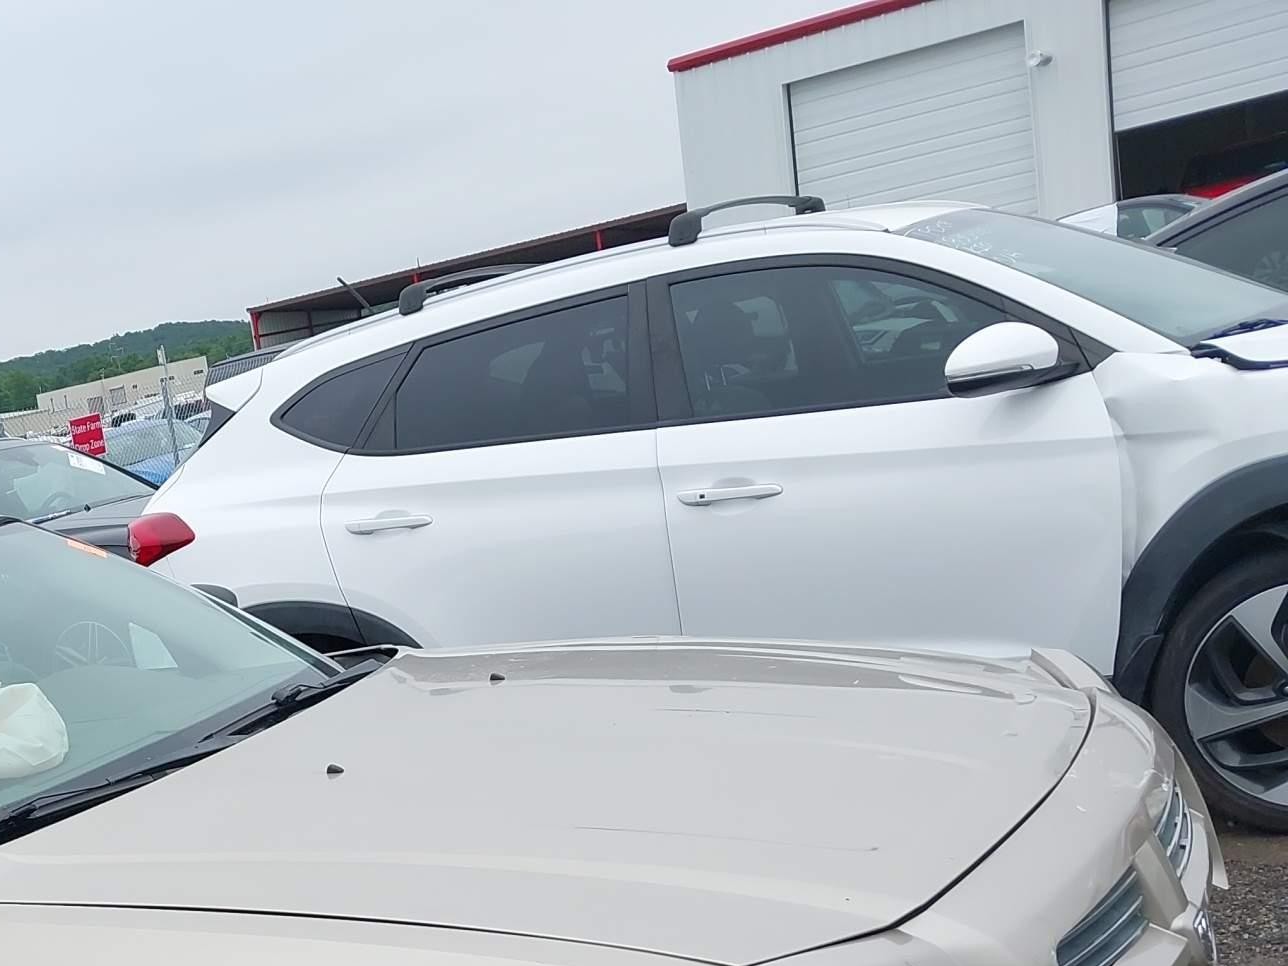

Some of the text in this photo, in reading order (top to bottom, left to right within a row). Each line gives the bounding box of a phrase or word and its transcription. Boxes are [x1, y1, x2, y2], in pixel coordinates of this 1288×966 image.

[72, 421, 101, 435] State Farm
[90, 440, 104, 449] Zone
